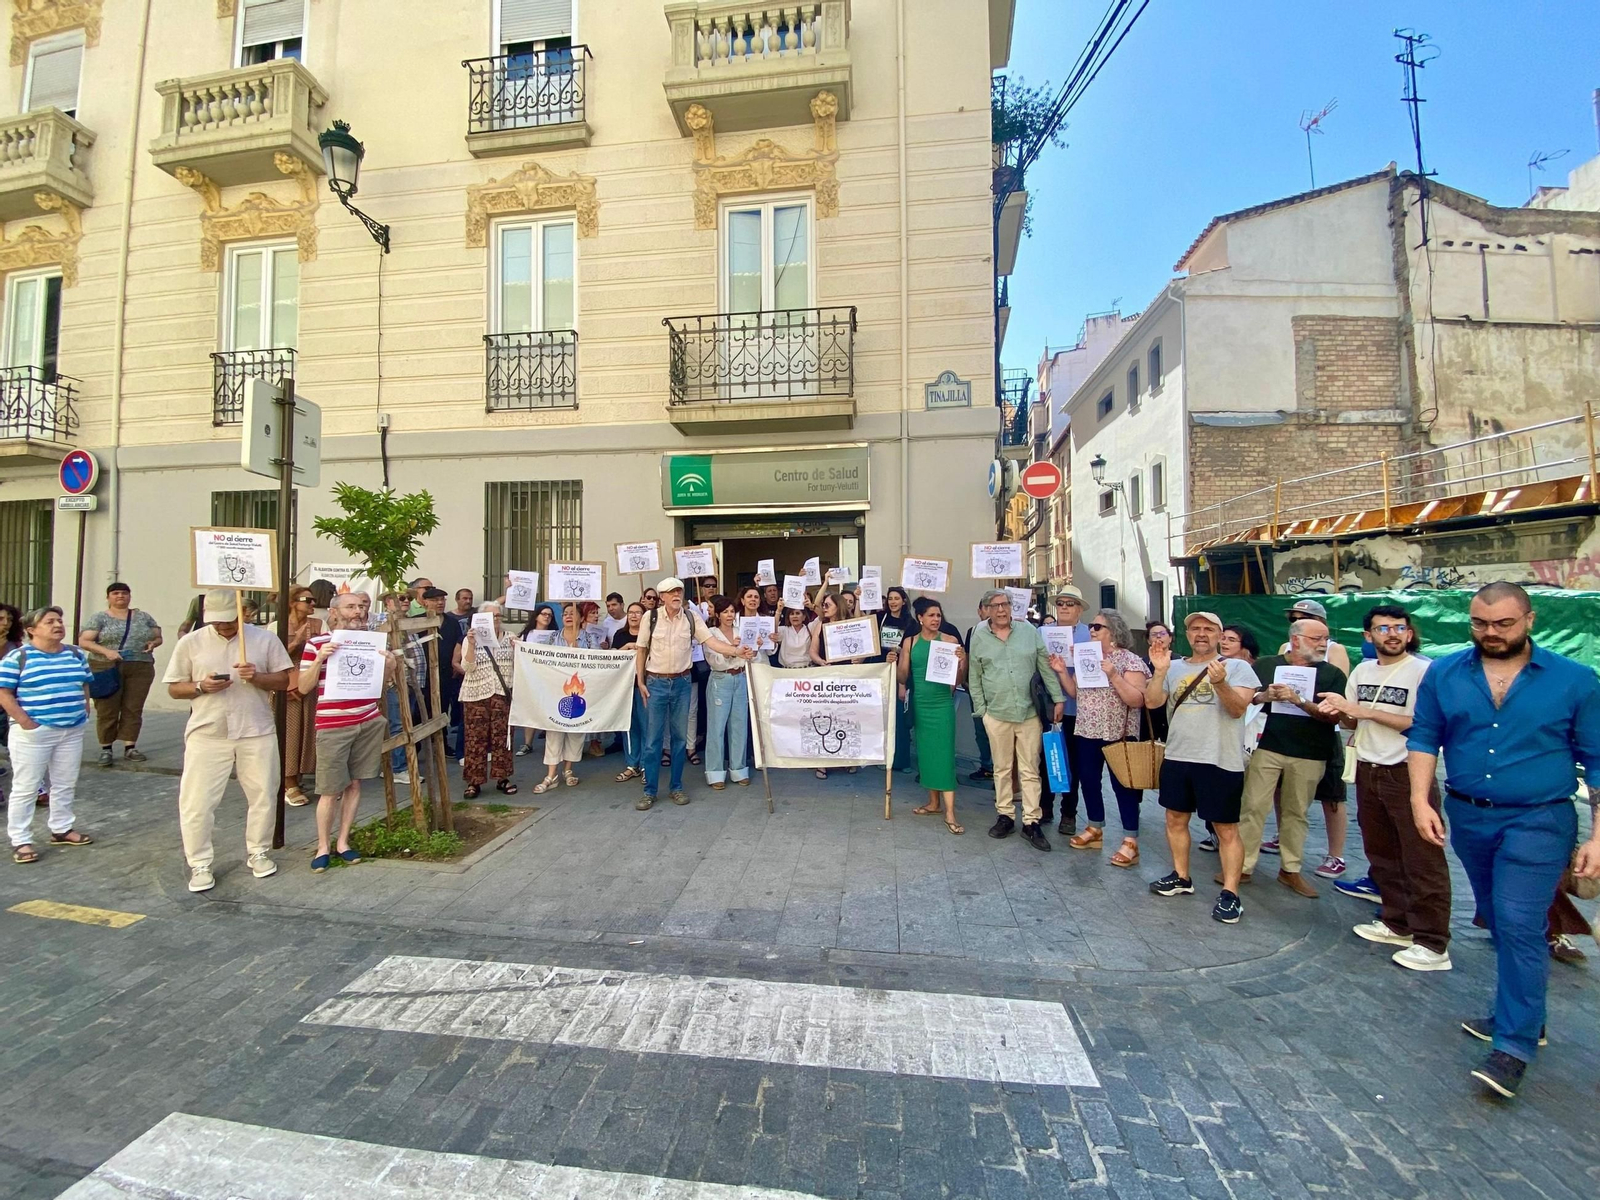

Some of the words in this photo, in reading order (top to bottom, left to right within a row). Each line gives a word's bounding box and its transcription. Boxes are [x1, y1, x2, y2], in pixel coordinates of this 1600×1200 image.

[930, 390, 966, 403] TINAJILLA
[774, 470, 808, 482] Centro
[812, 468, 825, 480] de
[828, 466, 858, 480] Salud
[794, 681, 811, 691] NO
[813, 681, 823, 691] al
[826, 681, 857, 691] cierre
